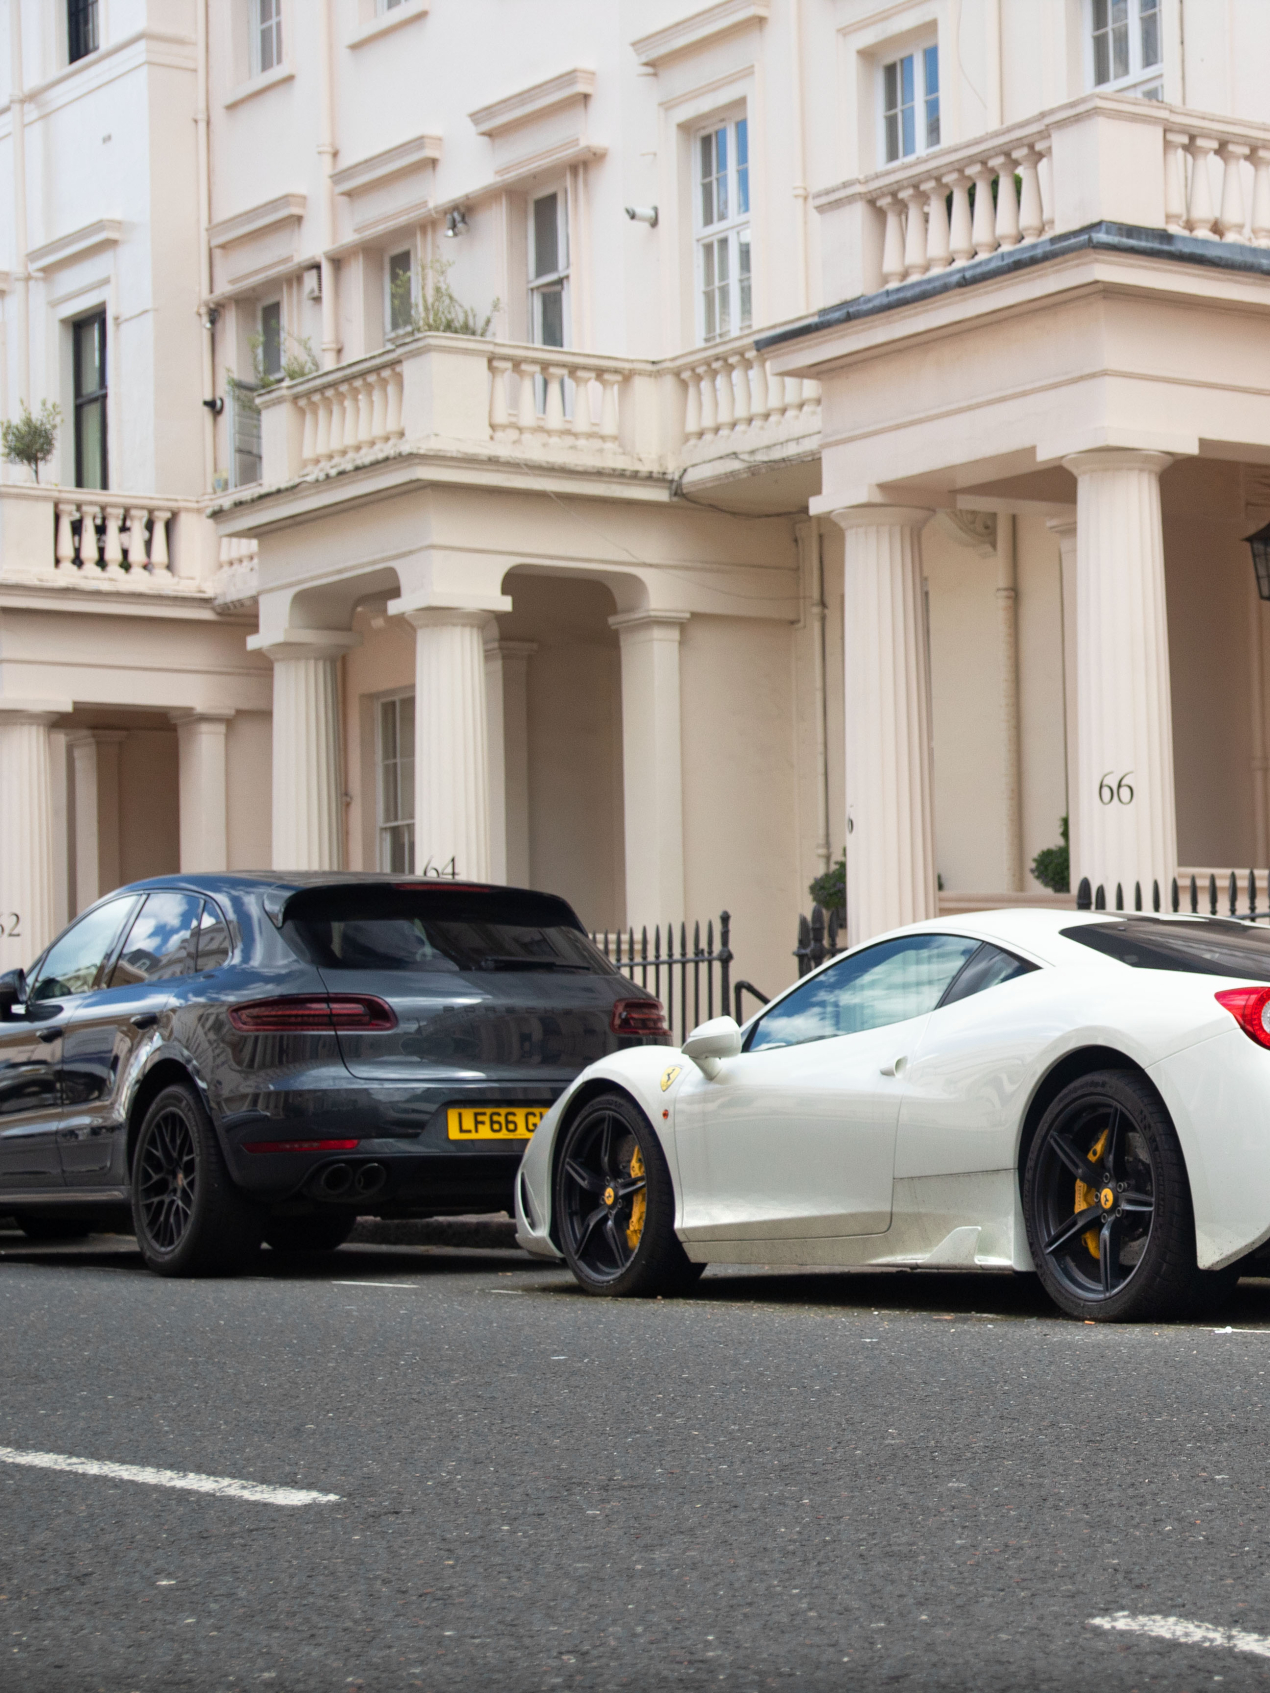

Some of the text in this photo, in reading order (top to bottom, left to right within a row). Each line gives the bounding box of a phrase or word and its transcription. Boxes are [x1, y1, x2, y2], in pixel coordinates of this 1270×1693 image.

[1098, 770, 1134, 806] 66
[0, 911, 21, 938] 2
[458, 1111, 545, 1134] LF66 G
